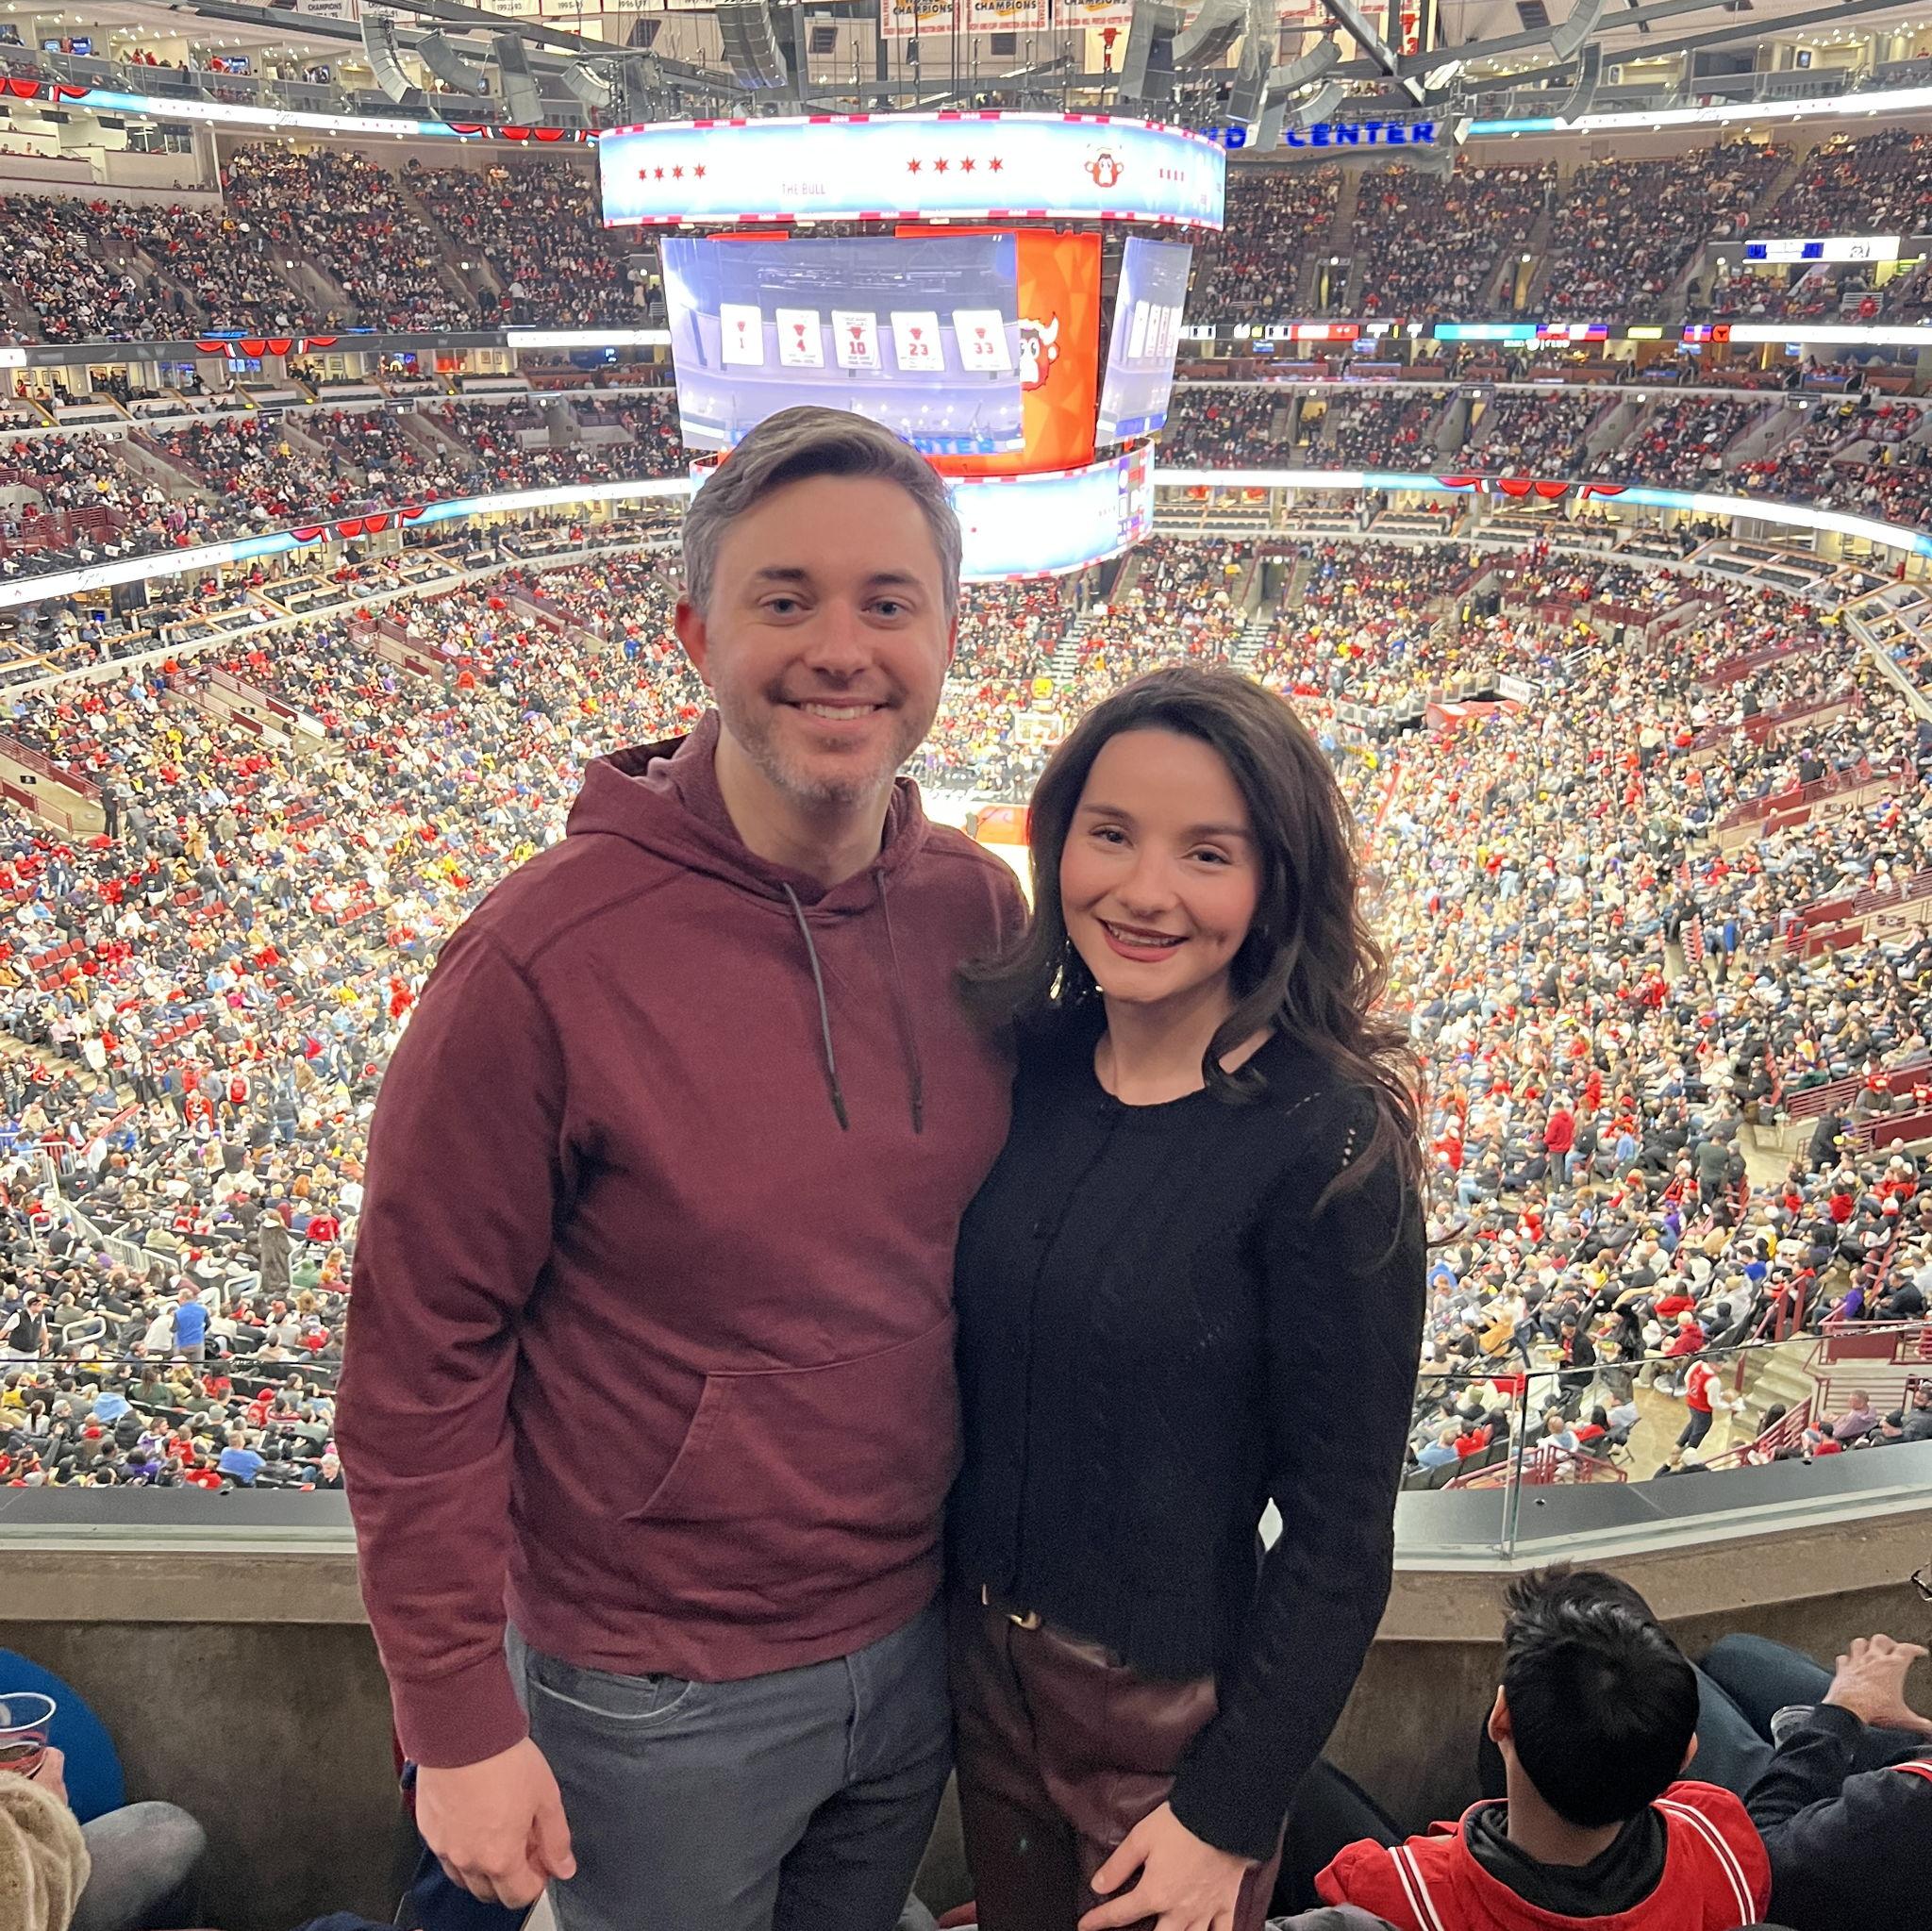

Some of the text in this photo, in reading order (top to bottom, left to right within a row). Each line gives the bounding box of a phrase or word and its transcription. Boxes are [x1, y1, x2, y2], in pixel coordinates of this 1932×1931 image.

[975, 0, 1037, 10] CHAMPIONS
[802, 183, 826, 195] BULL
[849, 341, 866, 355] 10
[908, 342, 929, 357] 23
[974, 342, 994, 355] 33
